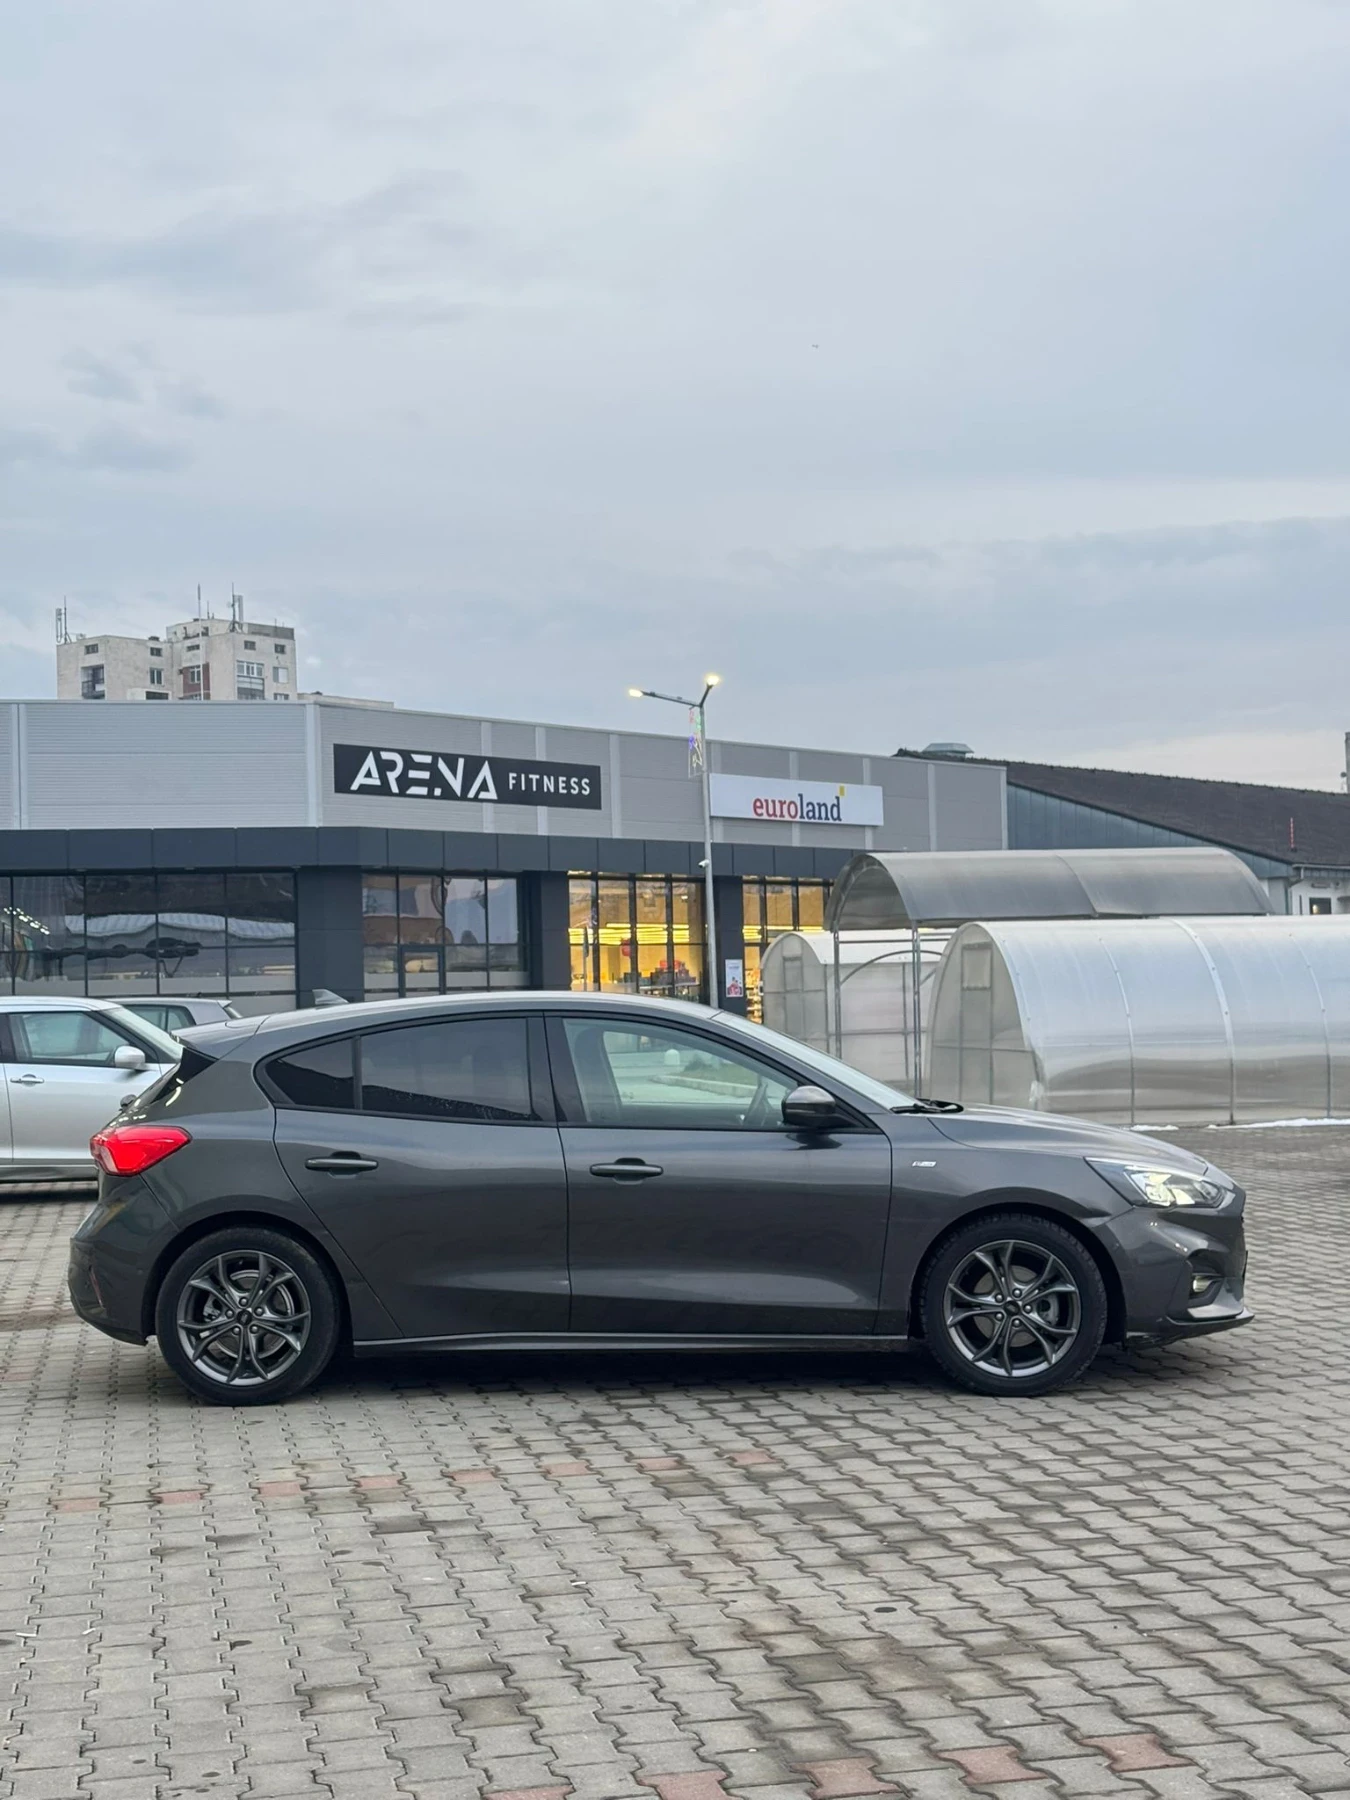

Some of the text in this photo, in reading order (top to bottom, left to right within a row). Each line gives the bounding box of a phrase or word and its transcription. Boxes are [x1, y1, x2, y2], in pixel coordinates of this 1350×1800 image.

[350, 751, 591, 800] ARENA FITNESS
[753, 793, 842, 822] euroland
